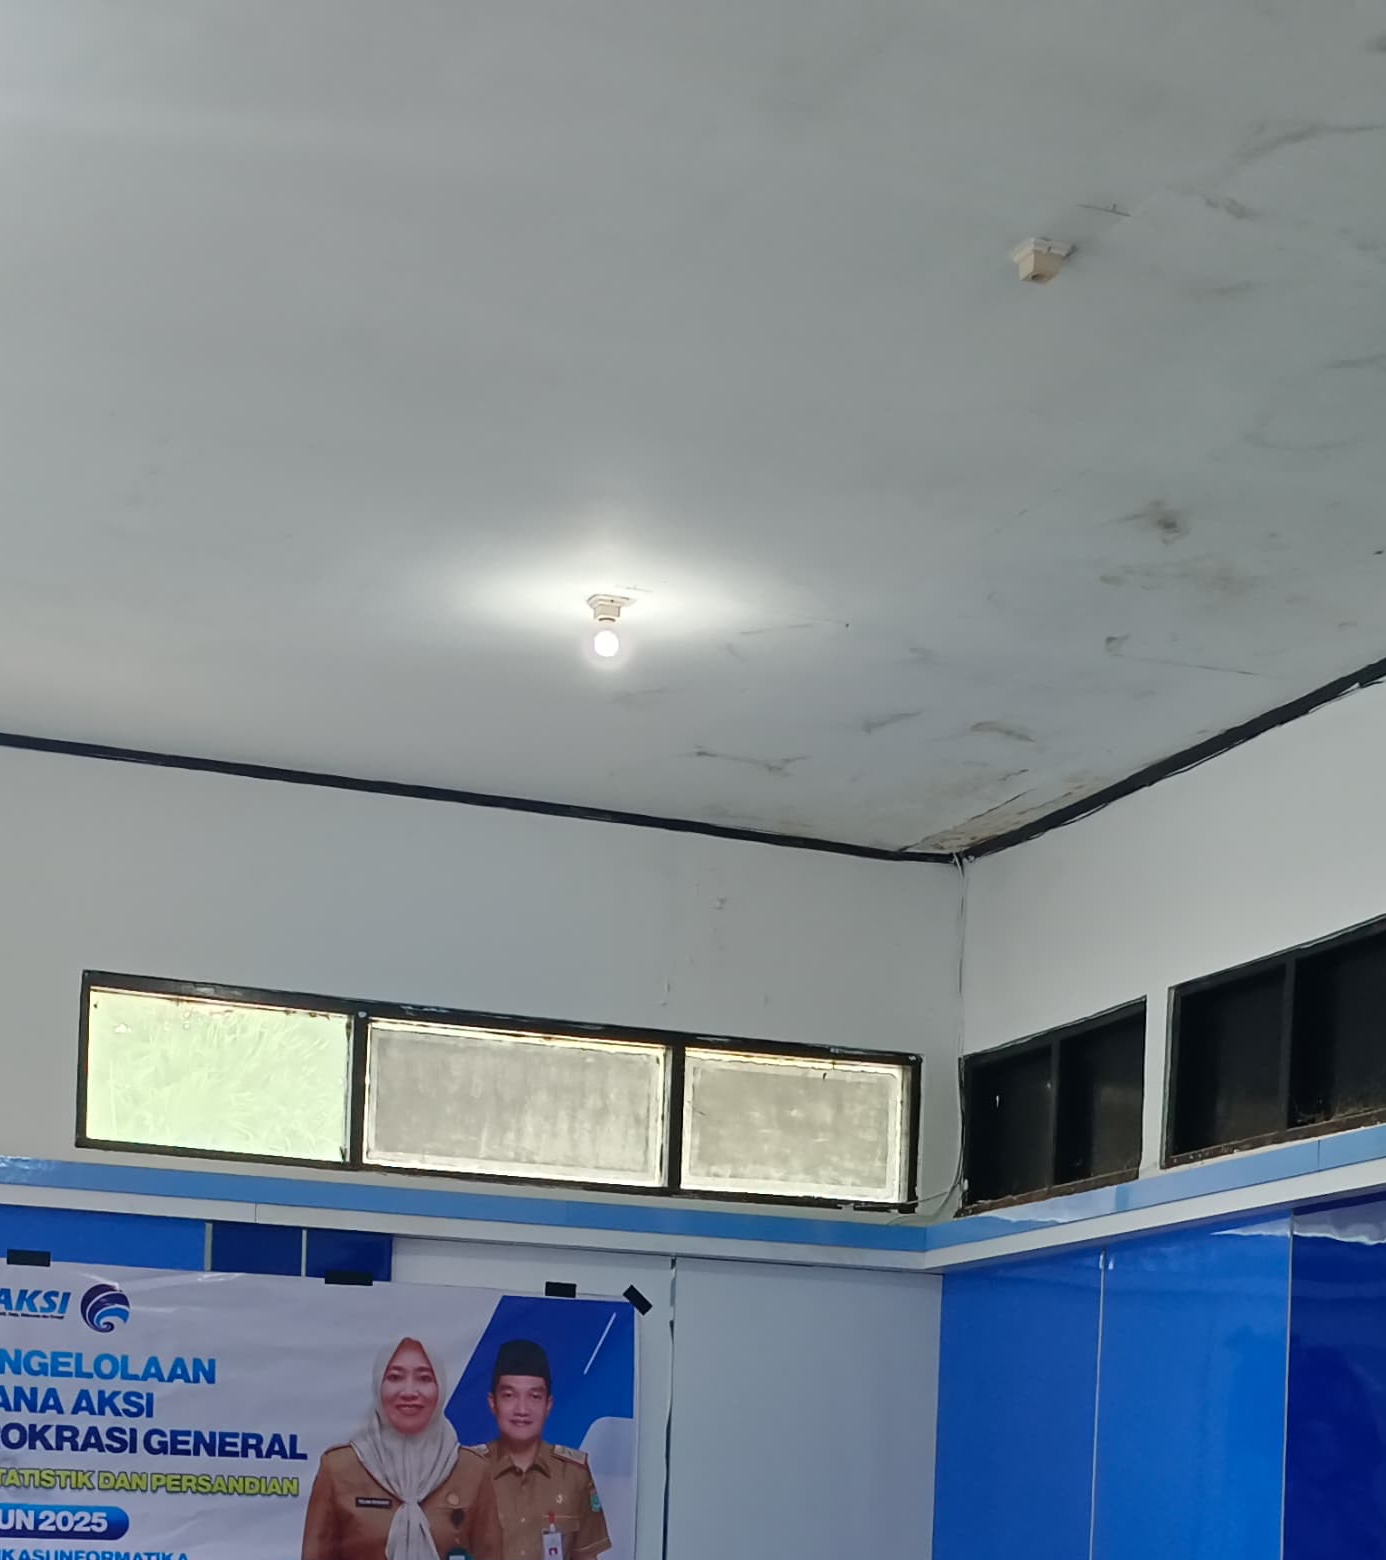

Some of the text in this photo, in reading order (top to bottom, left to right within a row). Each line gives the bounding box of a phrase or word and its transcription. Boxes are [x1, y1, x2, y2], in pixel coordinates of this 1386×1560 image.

[71, 1388, 154, 1418] AKSI
[143, 1428, 308, 1460] GENERAL
[97, 1471, 148, 1493] DAN
[150, 1473, 300, 1497] PERSANDIAN
[38, 1509, 109, 1533] 2025
